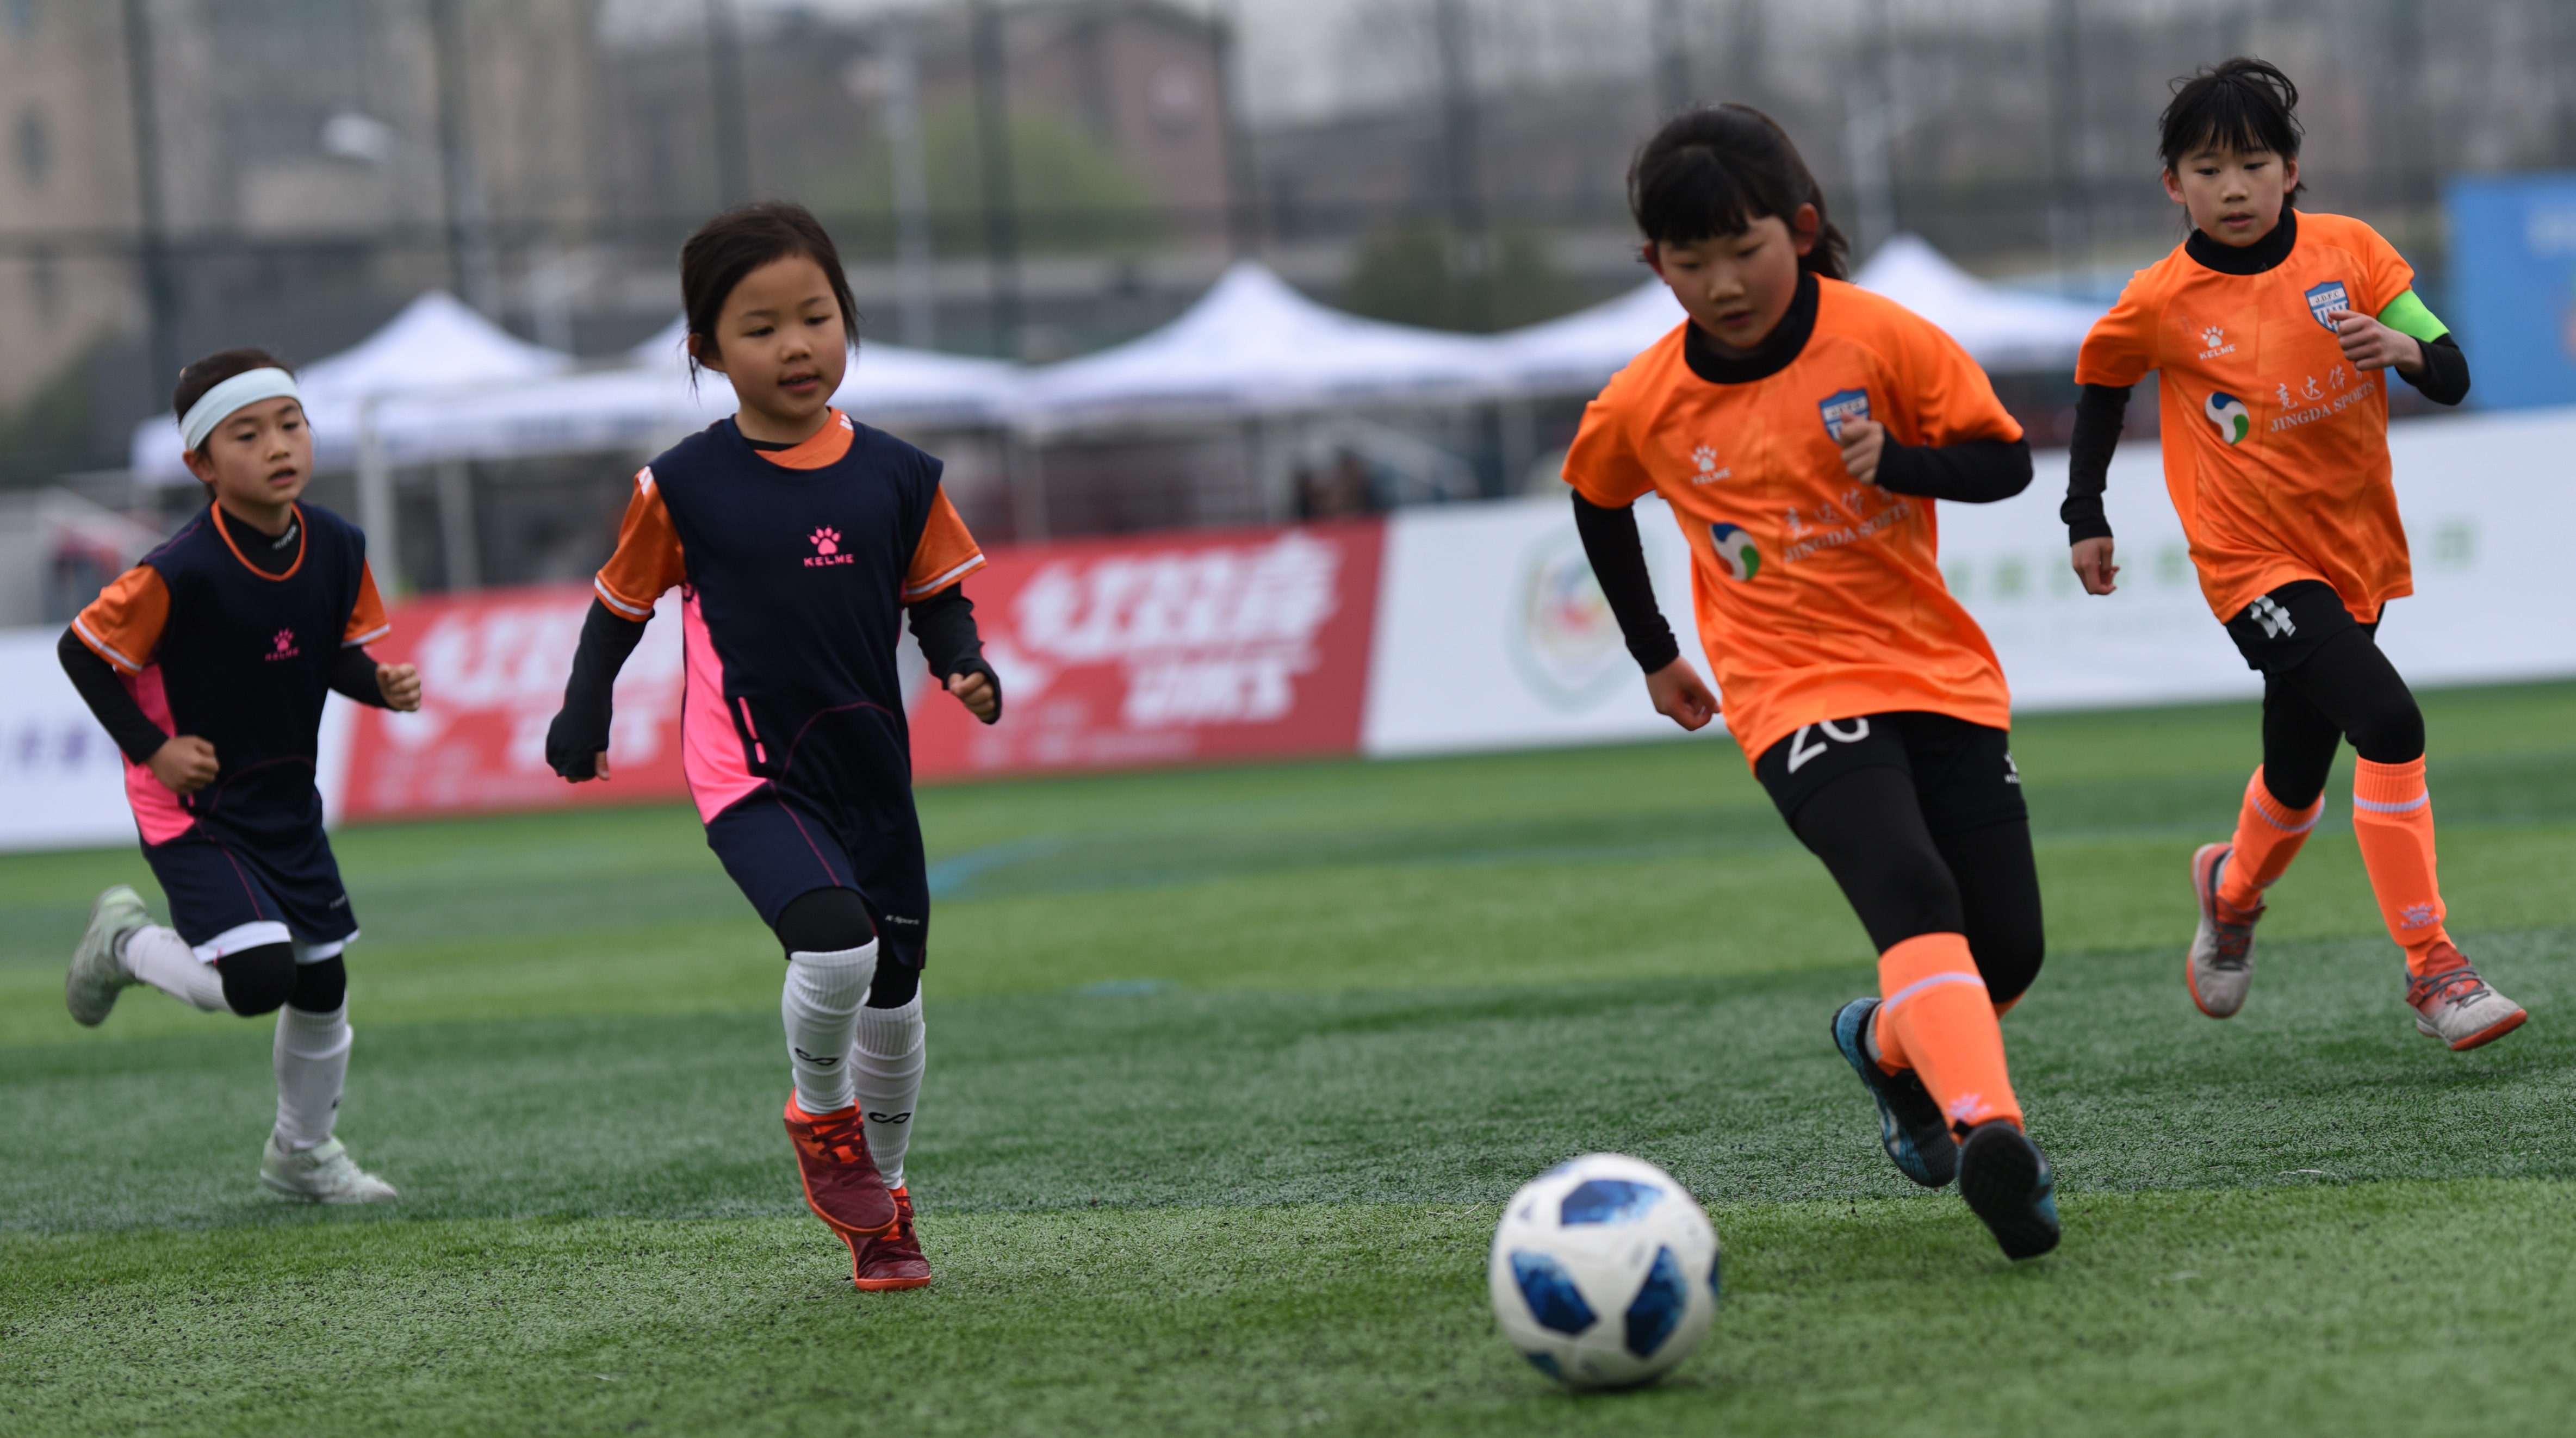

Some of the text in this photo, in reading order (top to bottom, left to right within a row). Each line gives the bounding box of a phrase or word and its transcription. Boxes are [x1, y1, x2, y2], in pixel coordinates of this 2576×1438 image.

[2199, 344, 2236, 360] KELME
[2270, 379, 2375, 432] JINGDA SPORTS
[1858, 500, 1910, 539] SORTS
[804, 553, 854, 568] KELME
